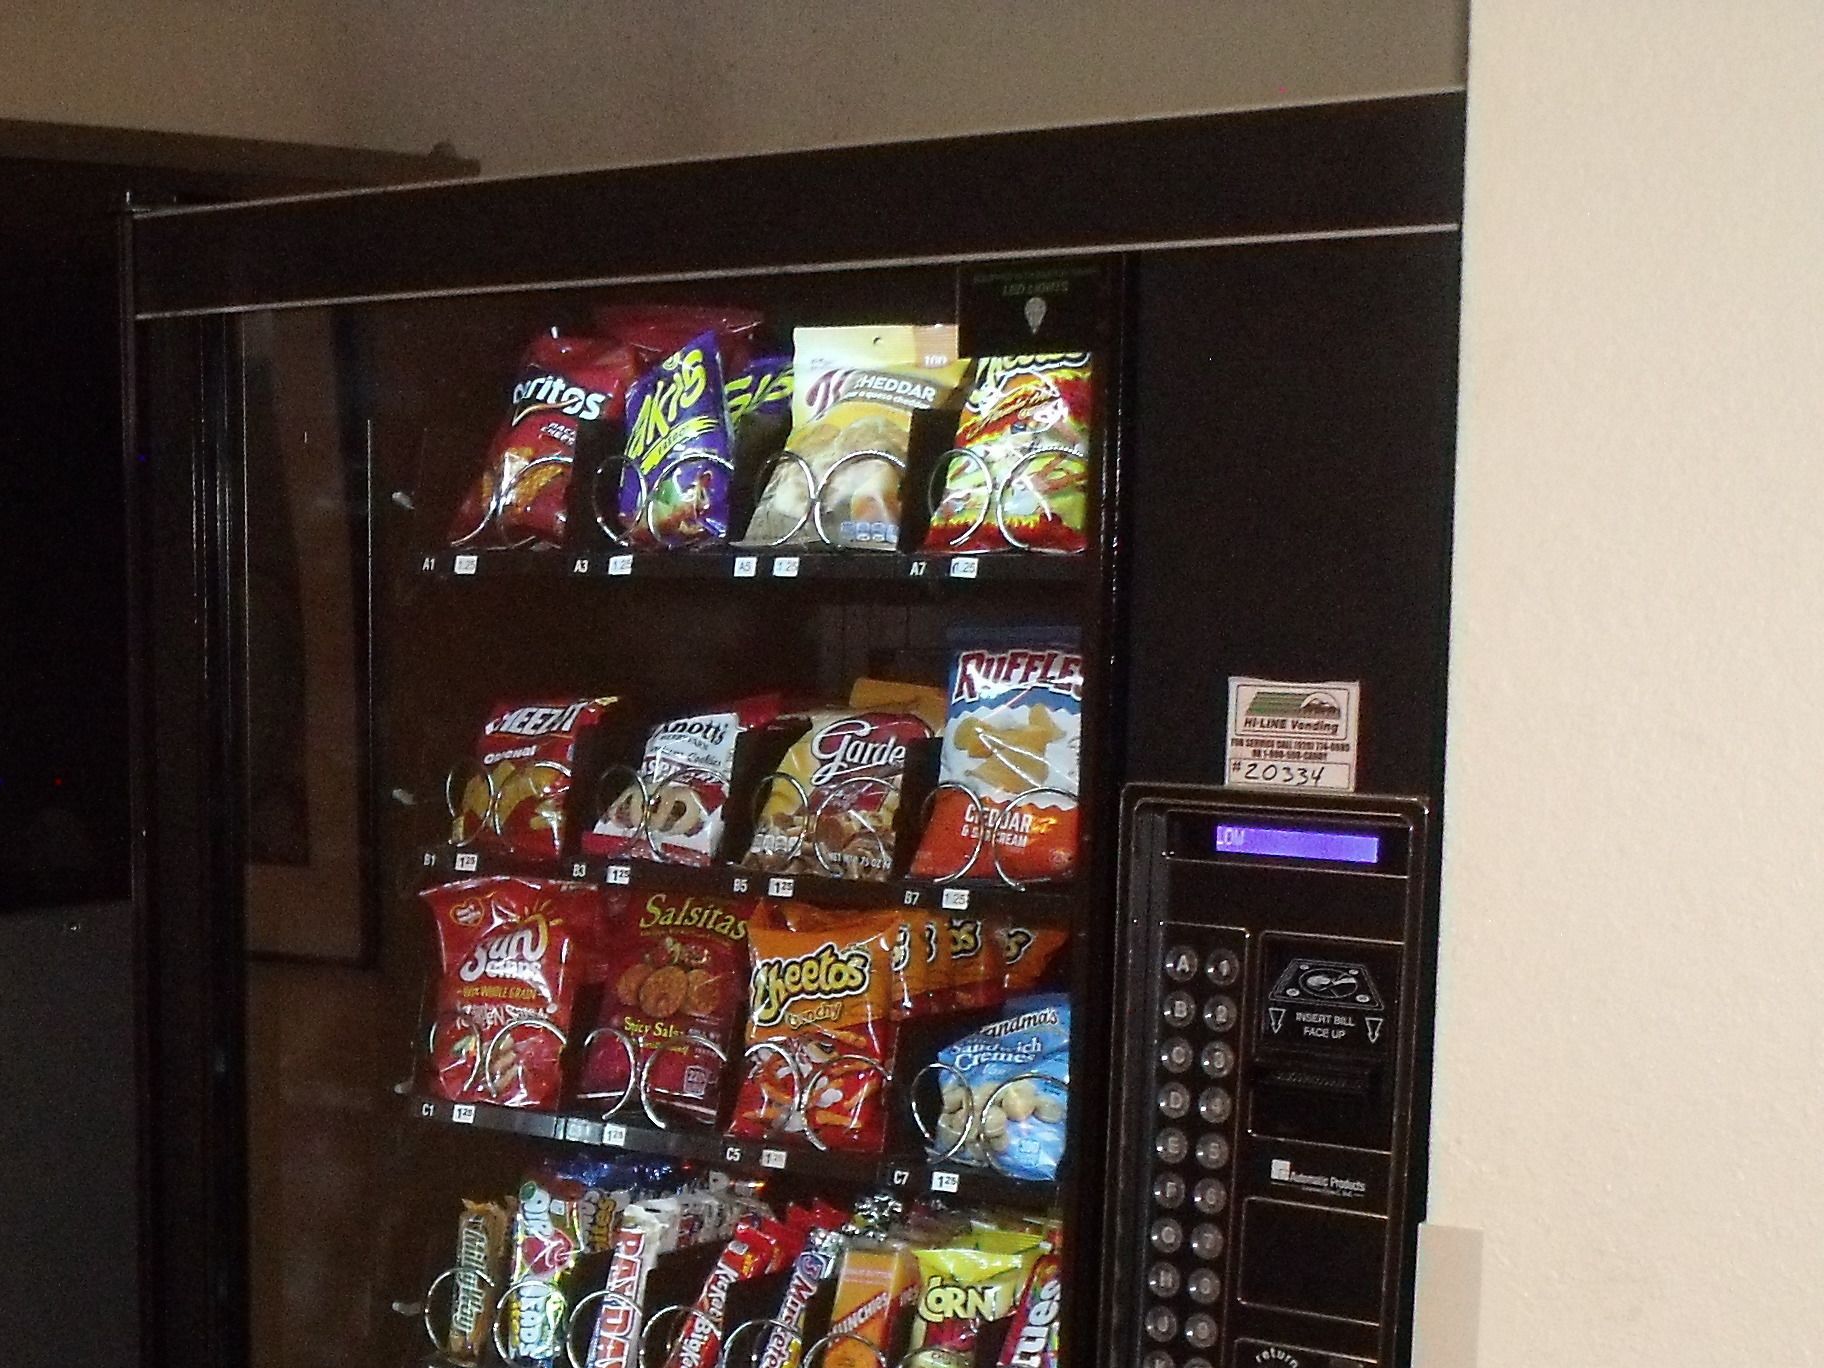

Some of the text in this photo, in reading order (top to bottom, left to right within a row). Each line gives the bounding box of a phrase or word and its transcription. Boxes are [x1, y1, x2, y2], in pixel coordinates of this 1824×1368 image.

[513, 375, 607, 420] oritos
[627, 349, 707, 459] AKIS
[422, 557, 436, 572] A1
[574, 560, 589, 574] A3
[909, 562, 926, 576] A7
[1291, 720, 1339, 736] Vending
[1244, 763, 1325, 786] 20334
[639, 893, 747, 940] Salsitas
[1175, 955, 1190, 973] A
[1296, 1011, 1356, 1028] INSERT BILL
[1303, 1026, 1346, 1039] FACE UP
[917, 1275, 997, 1323] CORN
[1255, 1347, 1299, 1368] return
